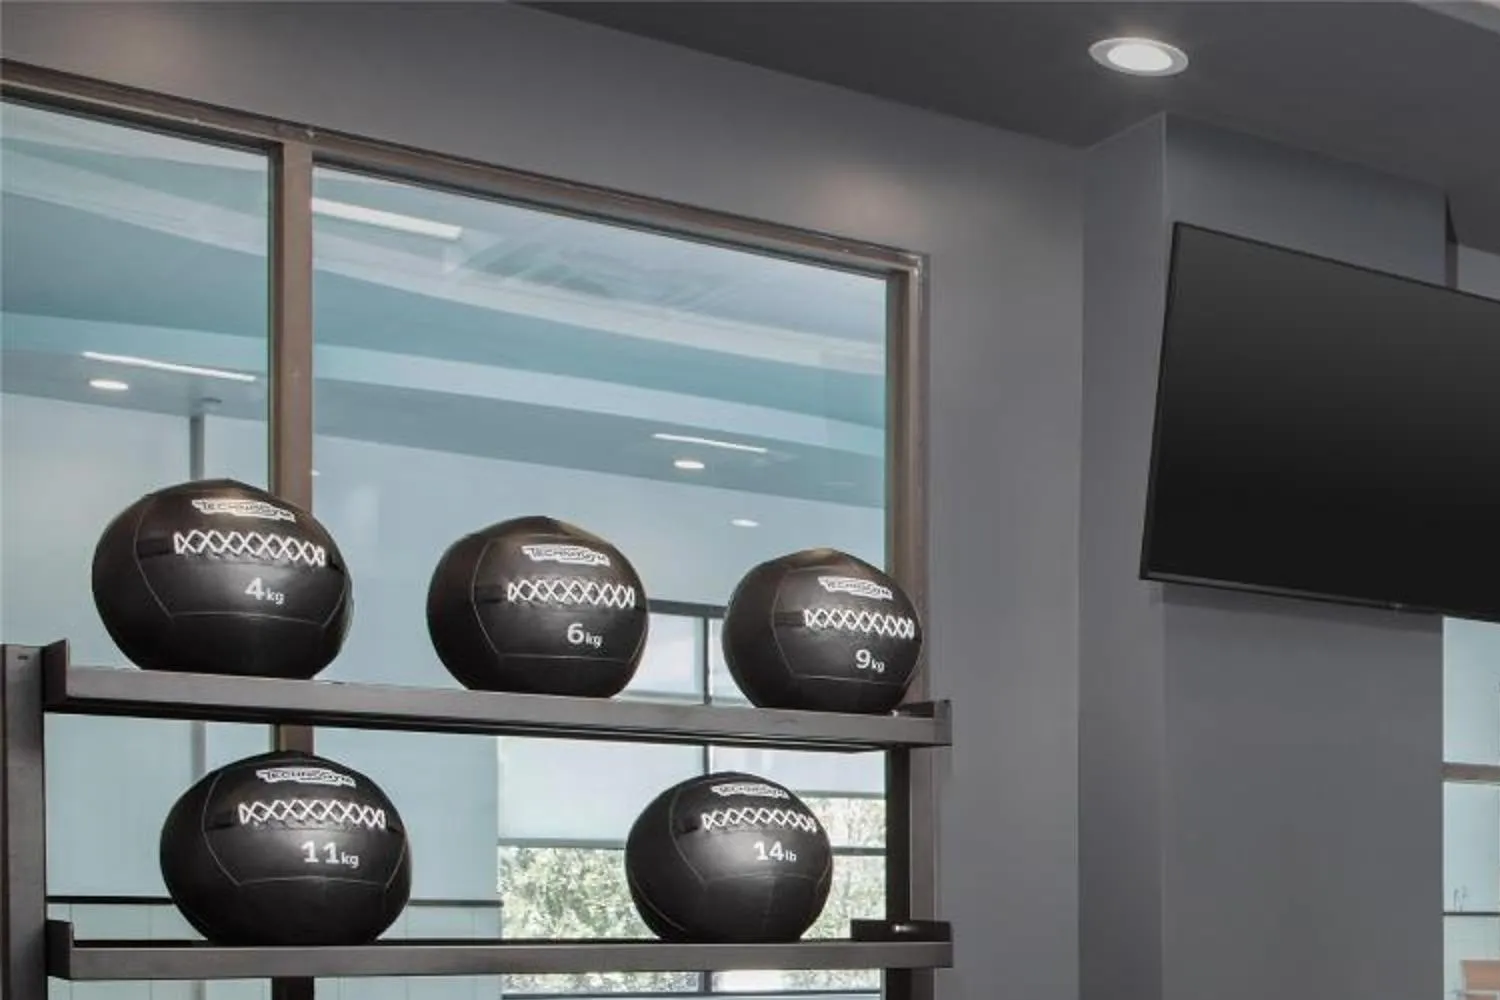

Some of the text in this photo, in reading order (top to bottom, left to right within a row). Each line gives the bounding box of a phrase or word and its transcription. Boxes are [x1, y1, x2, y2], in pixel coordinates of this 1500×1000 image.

[245, 577, 285, 604] 4kg
[567, 623, 603, 647] 6kg
[855, 649, 885, 672] 9kg
[301, 840, 360, 868] 11kg
[753, 841, 797, 862] 14lb
